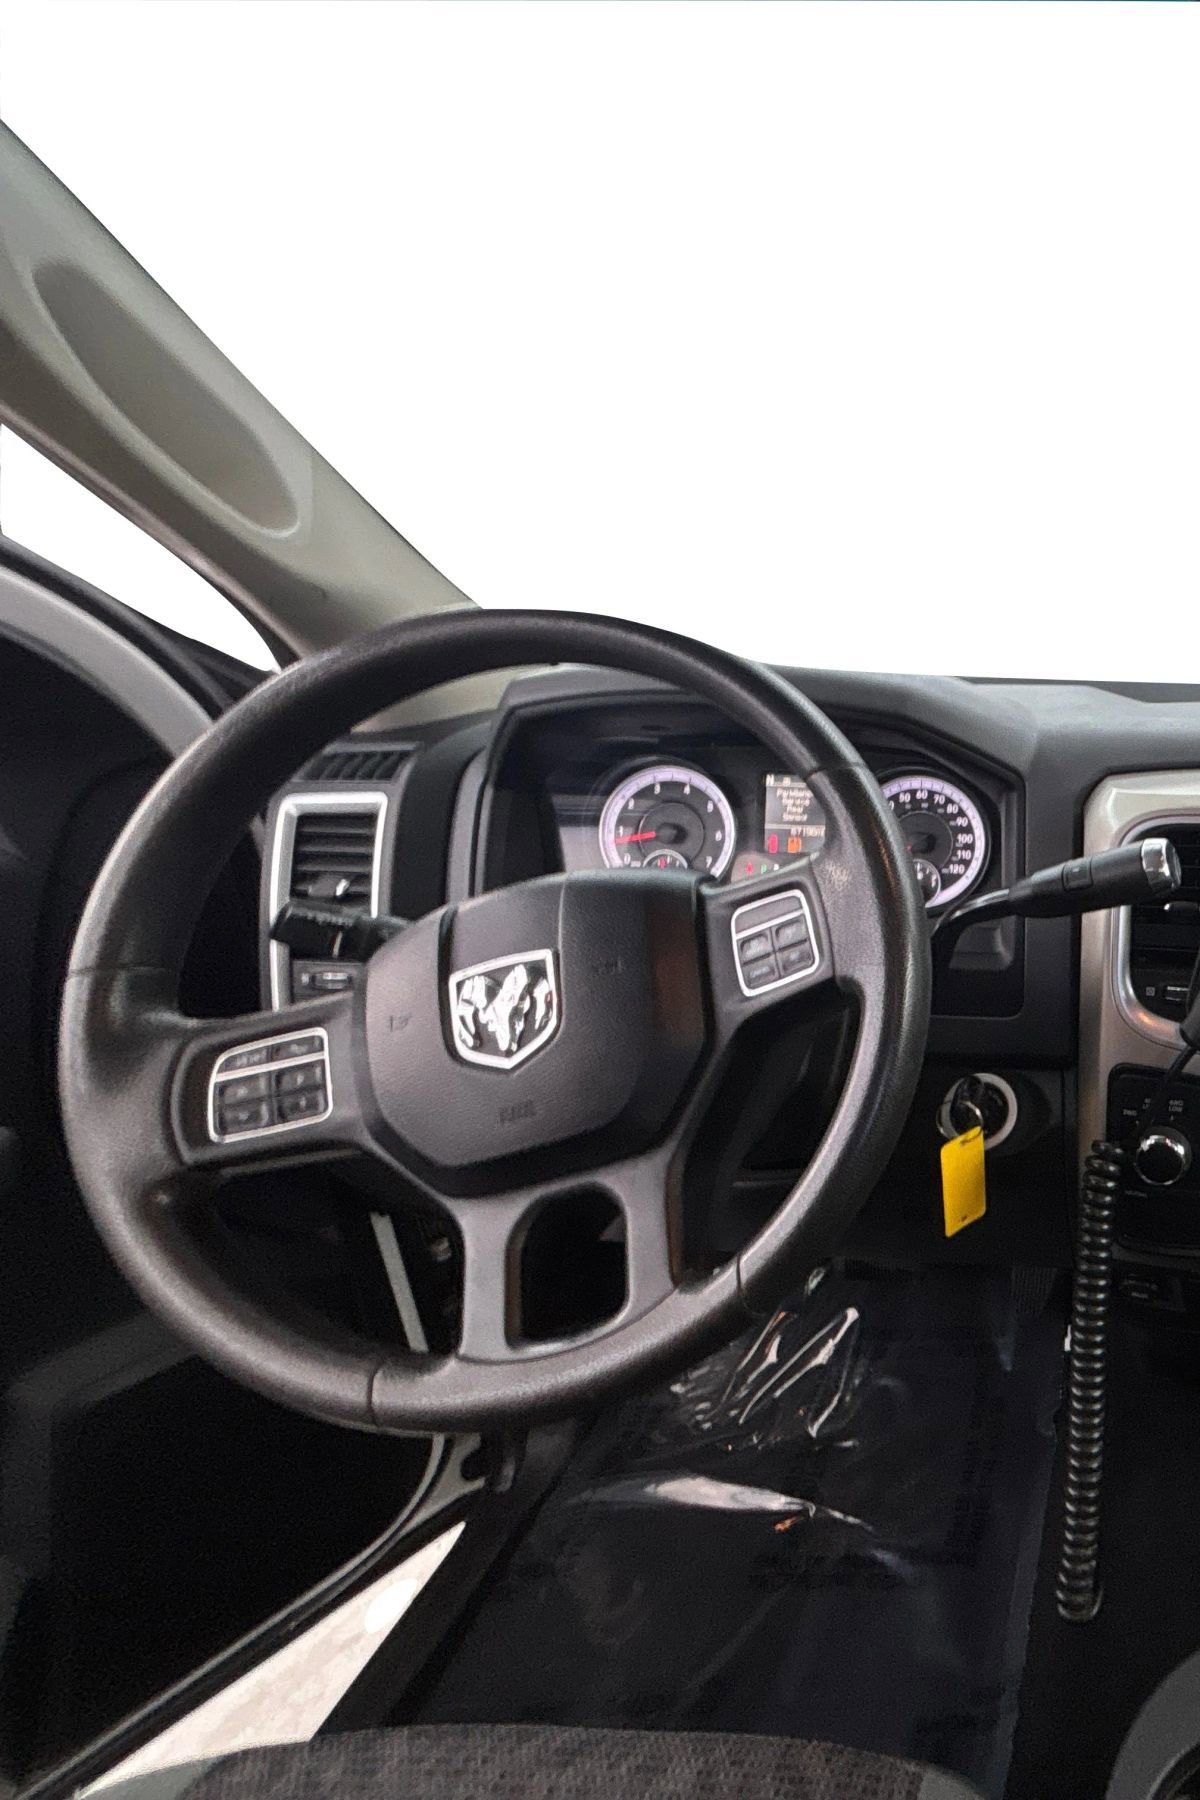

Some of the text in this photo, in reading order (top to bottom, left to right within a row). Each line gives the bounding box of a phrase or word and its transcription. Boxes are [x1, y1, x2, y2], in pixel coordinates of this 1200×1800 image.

[916, 790, 928, 800] 60
[933, 794, 946, 804] 70
[946, 803, 959, 814] 80
[956, 817, 968, 827] 90
[957, 834, 973, 844] 100
[956, 850, 972, 860] 110
[949, 864, 965, 874] 120
